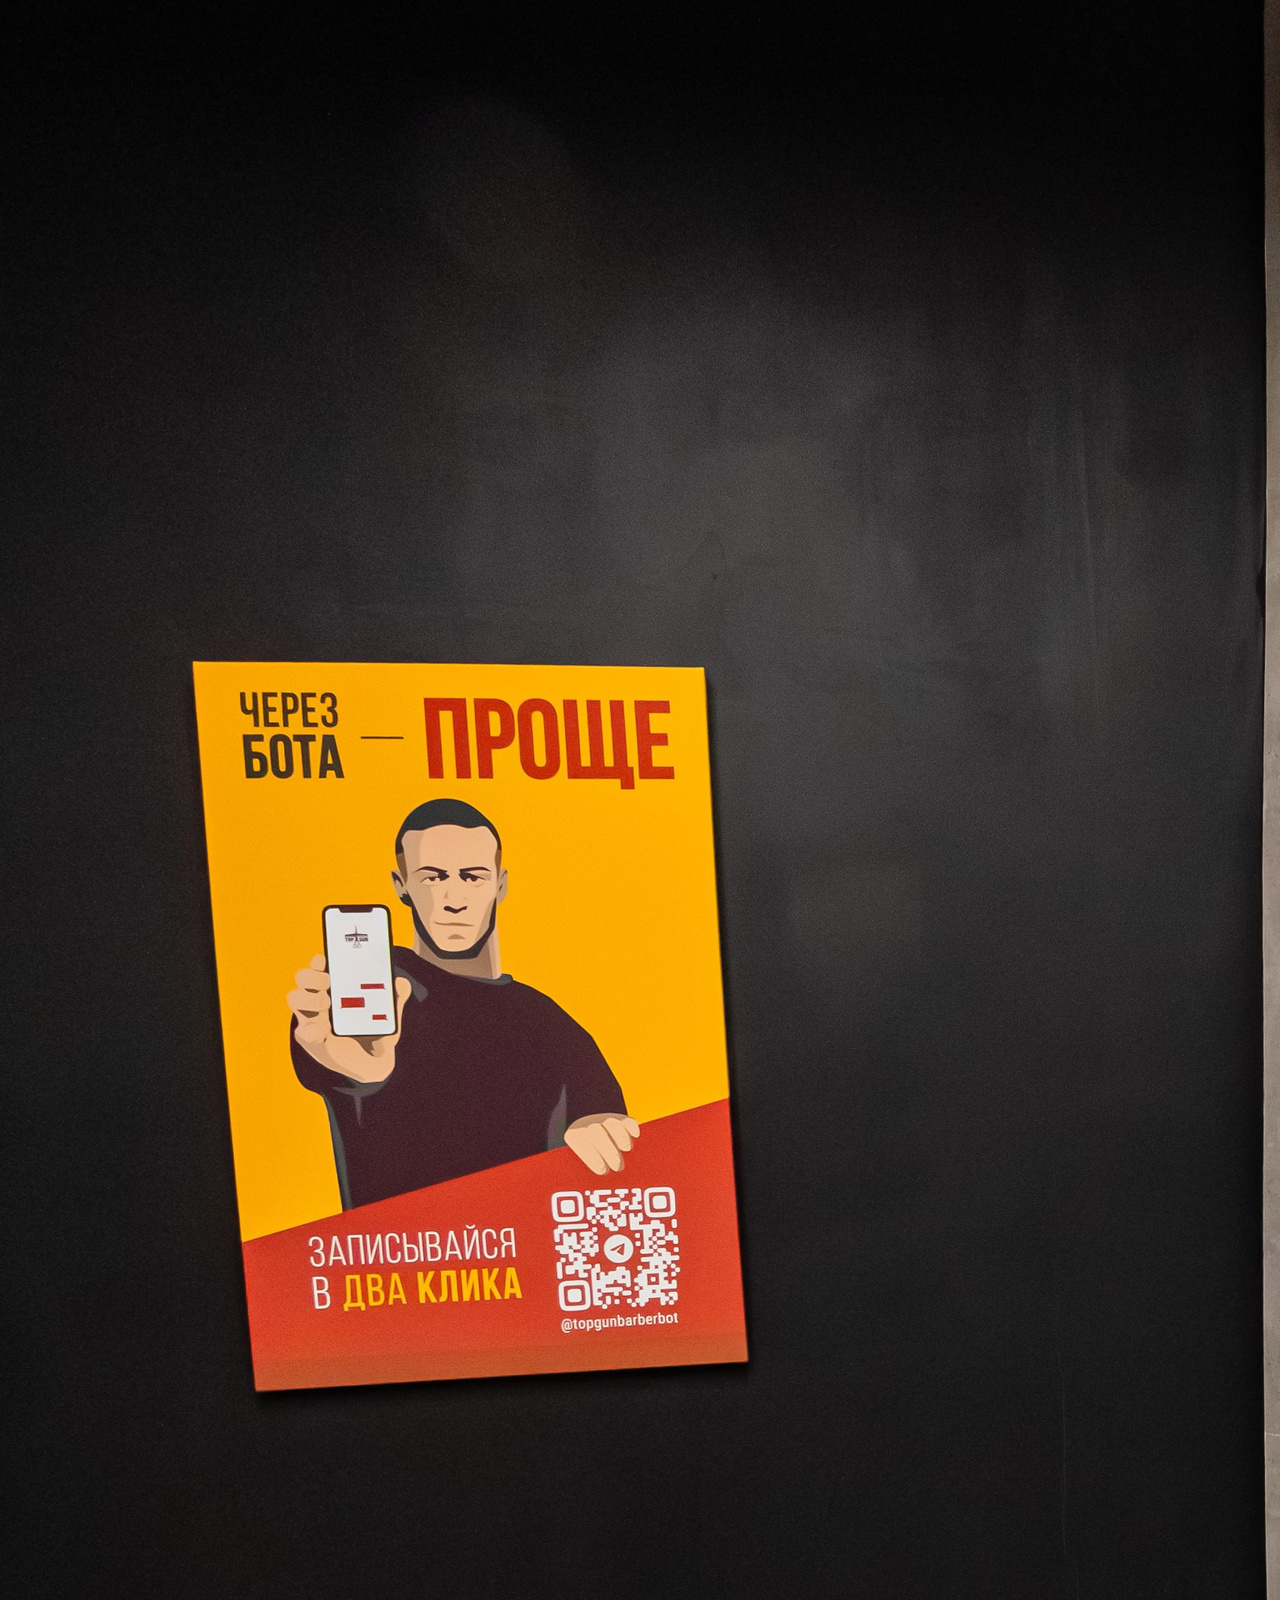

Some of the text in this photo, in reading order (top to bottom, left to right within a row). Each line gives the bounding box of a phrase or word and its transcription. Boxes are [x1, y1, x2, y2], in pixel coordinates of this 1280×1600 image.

[239, 691, 339, 729] ЧЕРЕЗ
[243, 733, 345, 780] БОТА
[423, 697, 675, 790] ПРОЩЕ
[308, 1225, 518, 1269] ЗАПИСЫВАЙСЯ
[312, 1267, 523, 1312] В ДВА КЛИКА
[560, 1312, 679, 1334] @topgunbarberbot
